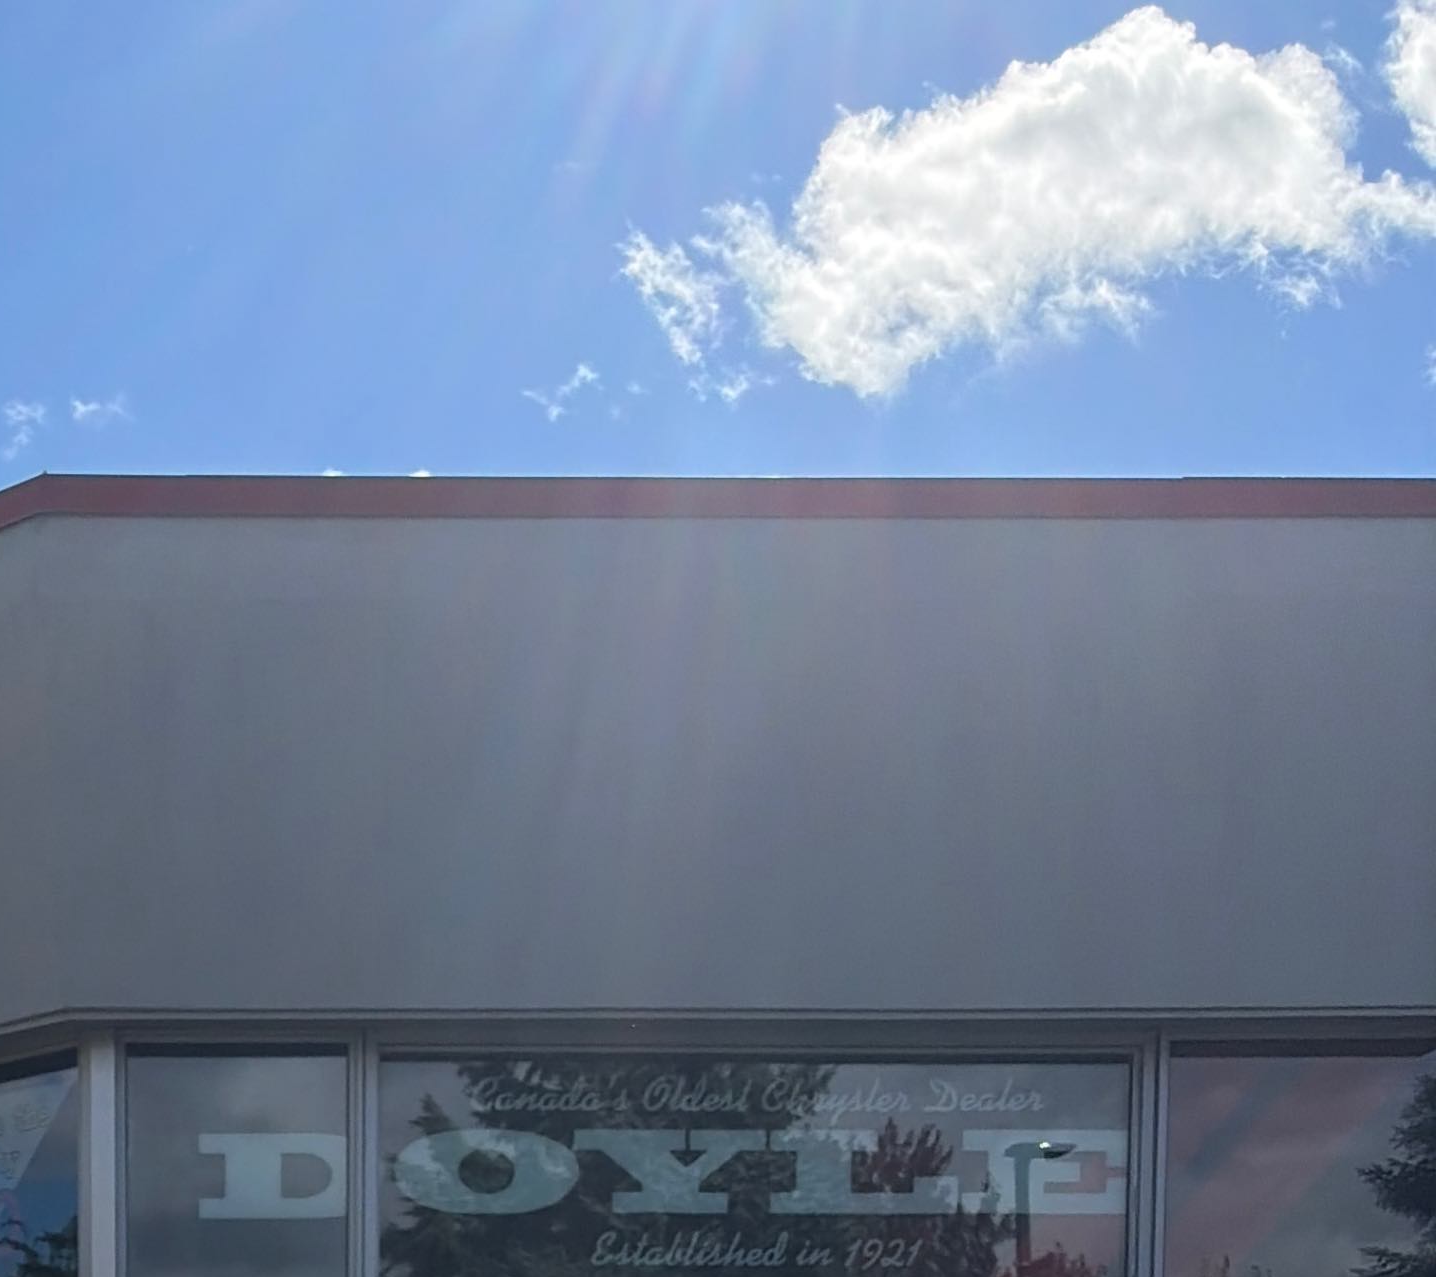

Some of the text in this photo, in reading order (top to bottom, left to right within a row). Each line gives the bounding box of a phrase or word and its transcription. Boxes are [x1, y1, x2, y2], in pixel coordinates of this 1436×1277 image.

[470, 1074, 1045, 1126] Canada's Oldest Chrysler Dealer
[198, 1130, 1127, 1219] DOYLE
[591, 1231, 924, 1270] Established in 1921
